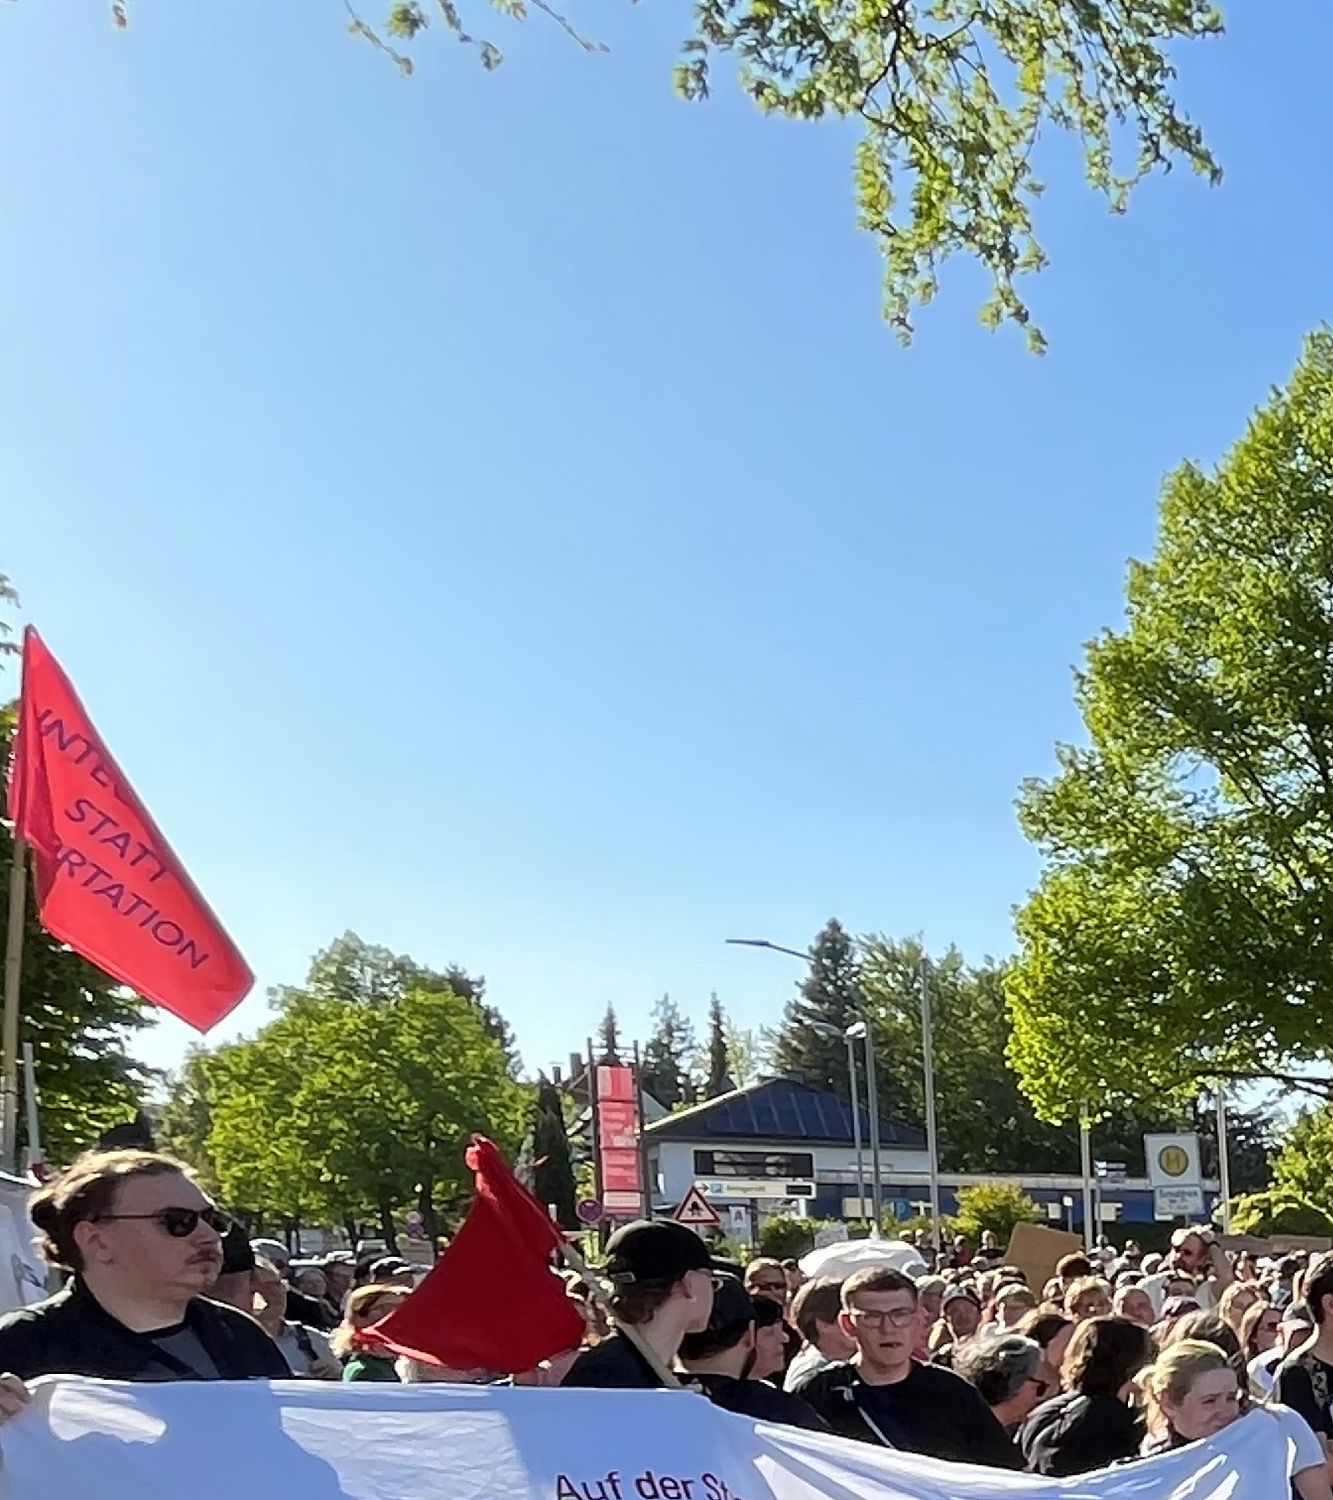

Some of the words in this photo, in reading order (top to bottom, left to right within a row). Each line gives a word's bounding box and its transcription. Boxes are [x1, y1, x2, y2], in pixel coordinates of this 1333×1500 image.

[38, 708, 128, 808] INTE
[64, 798, 168, 883] STATT
[56, 840, 210, 968] RTATION
